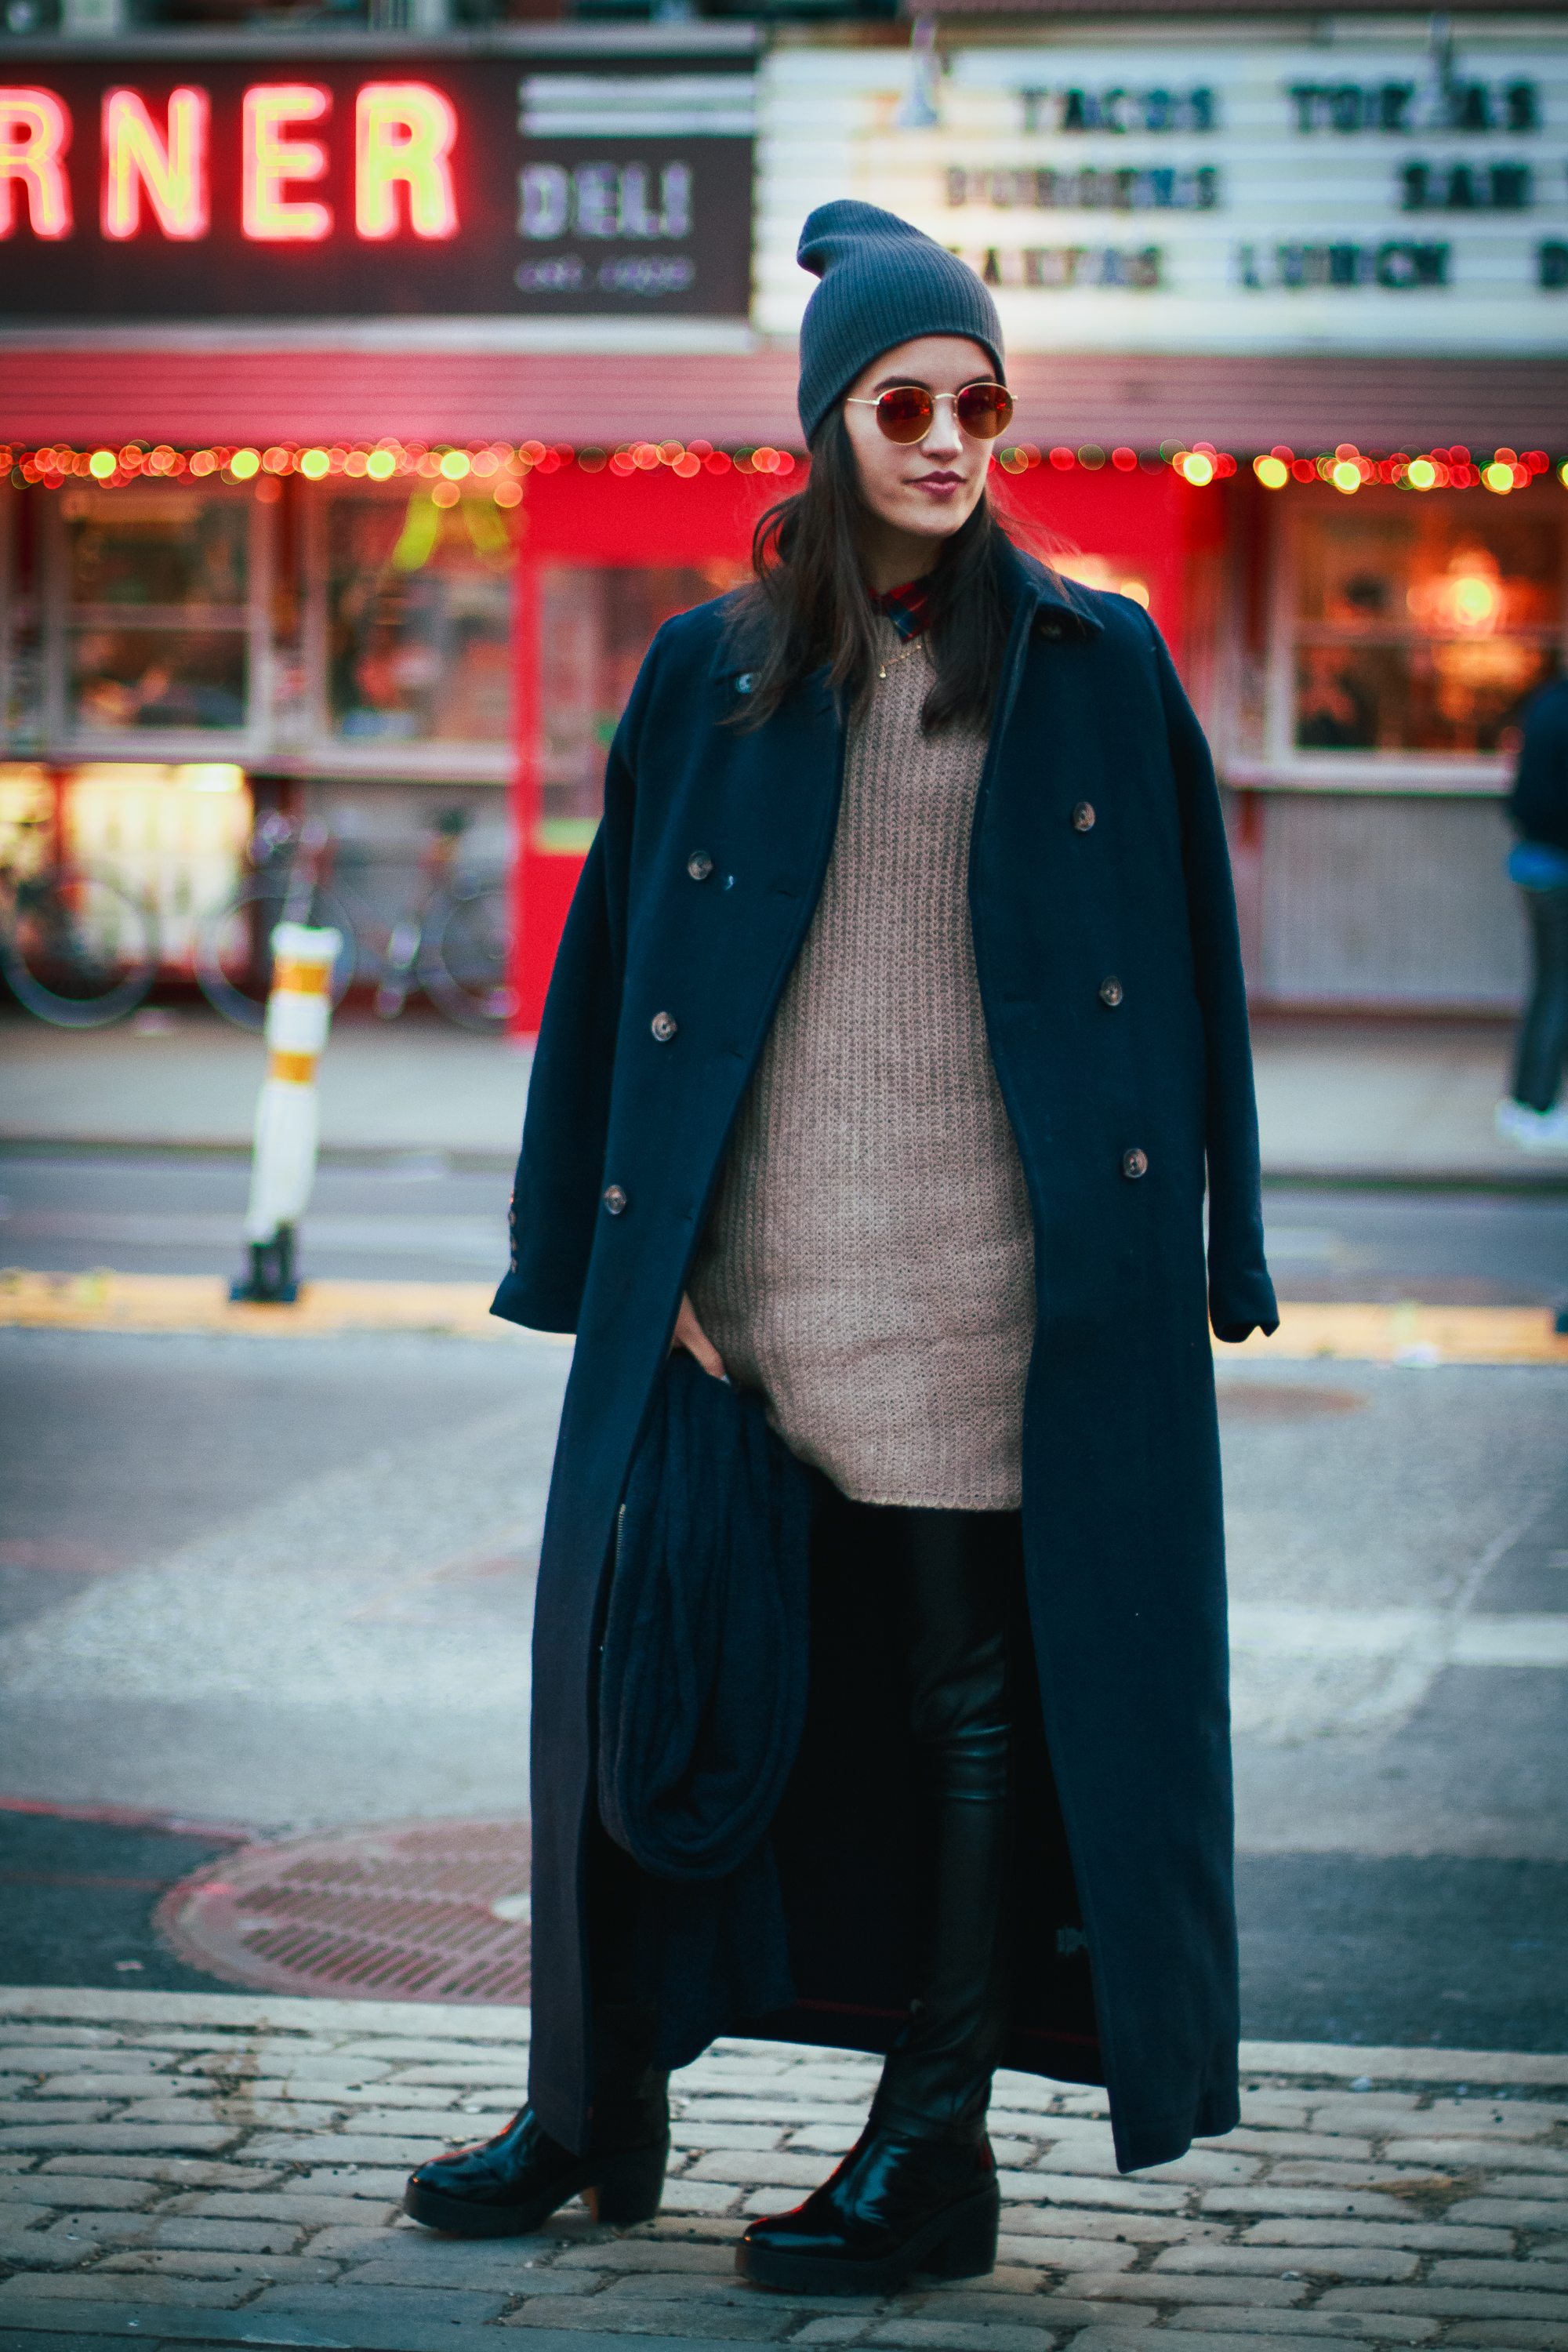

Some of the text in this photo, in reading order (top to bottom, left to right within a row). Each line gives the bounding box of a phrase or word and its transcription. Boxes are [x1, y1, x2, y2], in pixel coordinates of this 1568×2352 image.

[1018, 83, 1537, 133] TACOS TORAS
[517, 162, 693, 240] DELI
